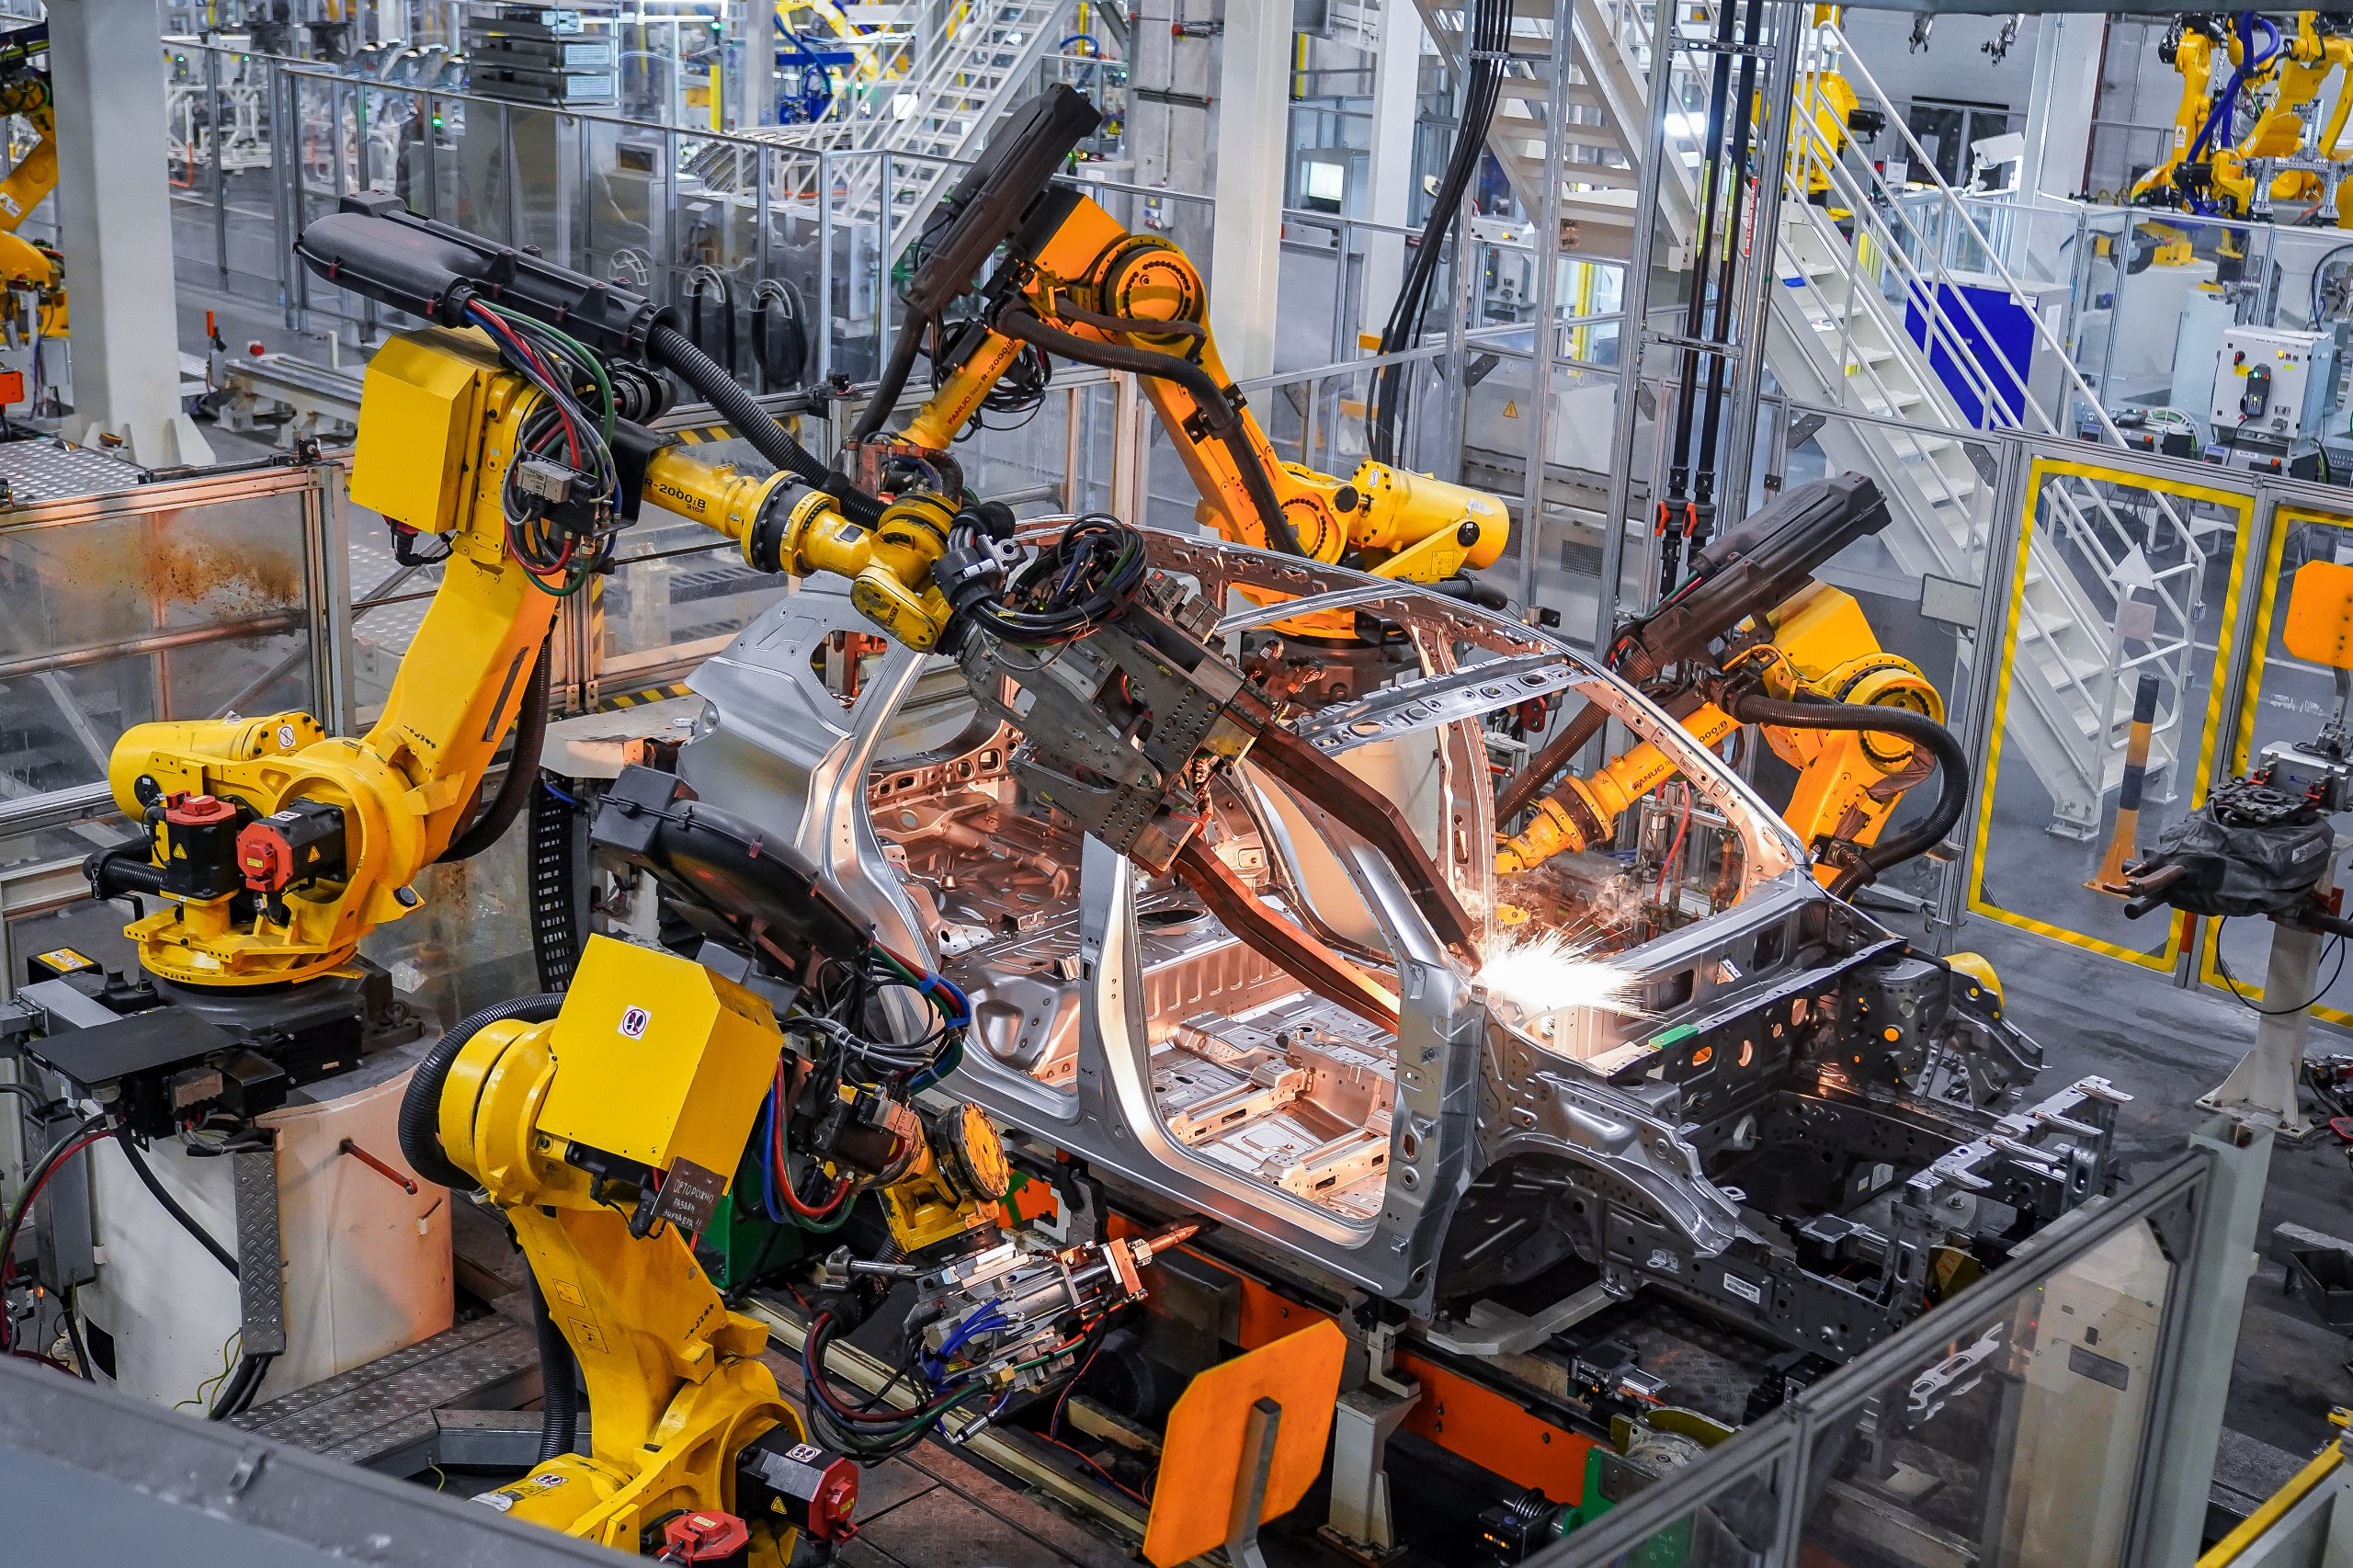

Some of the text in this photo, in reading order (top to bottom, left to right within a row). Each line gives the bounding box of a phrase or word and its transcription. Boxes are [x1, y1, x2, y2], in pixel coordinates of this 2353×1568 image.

[948, 396, 972, 426] FANUC
[643, 477, 706, 508] R-2000iB
[686, 504, 706, 514] 210F
[1632, 721, 1728, 790] FANUC 000iB
